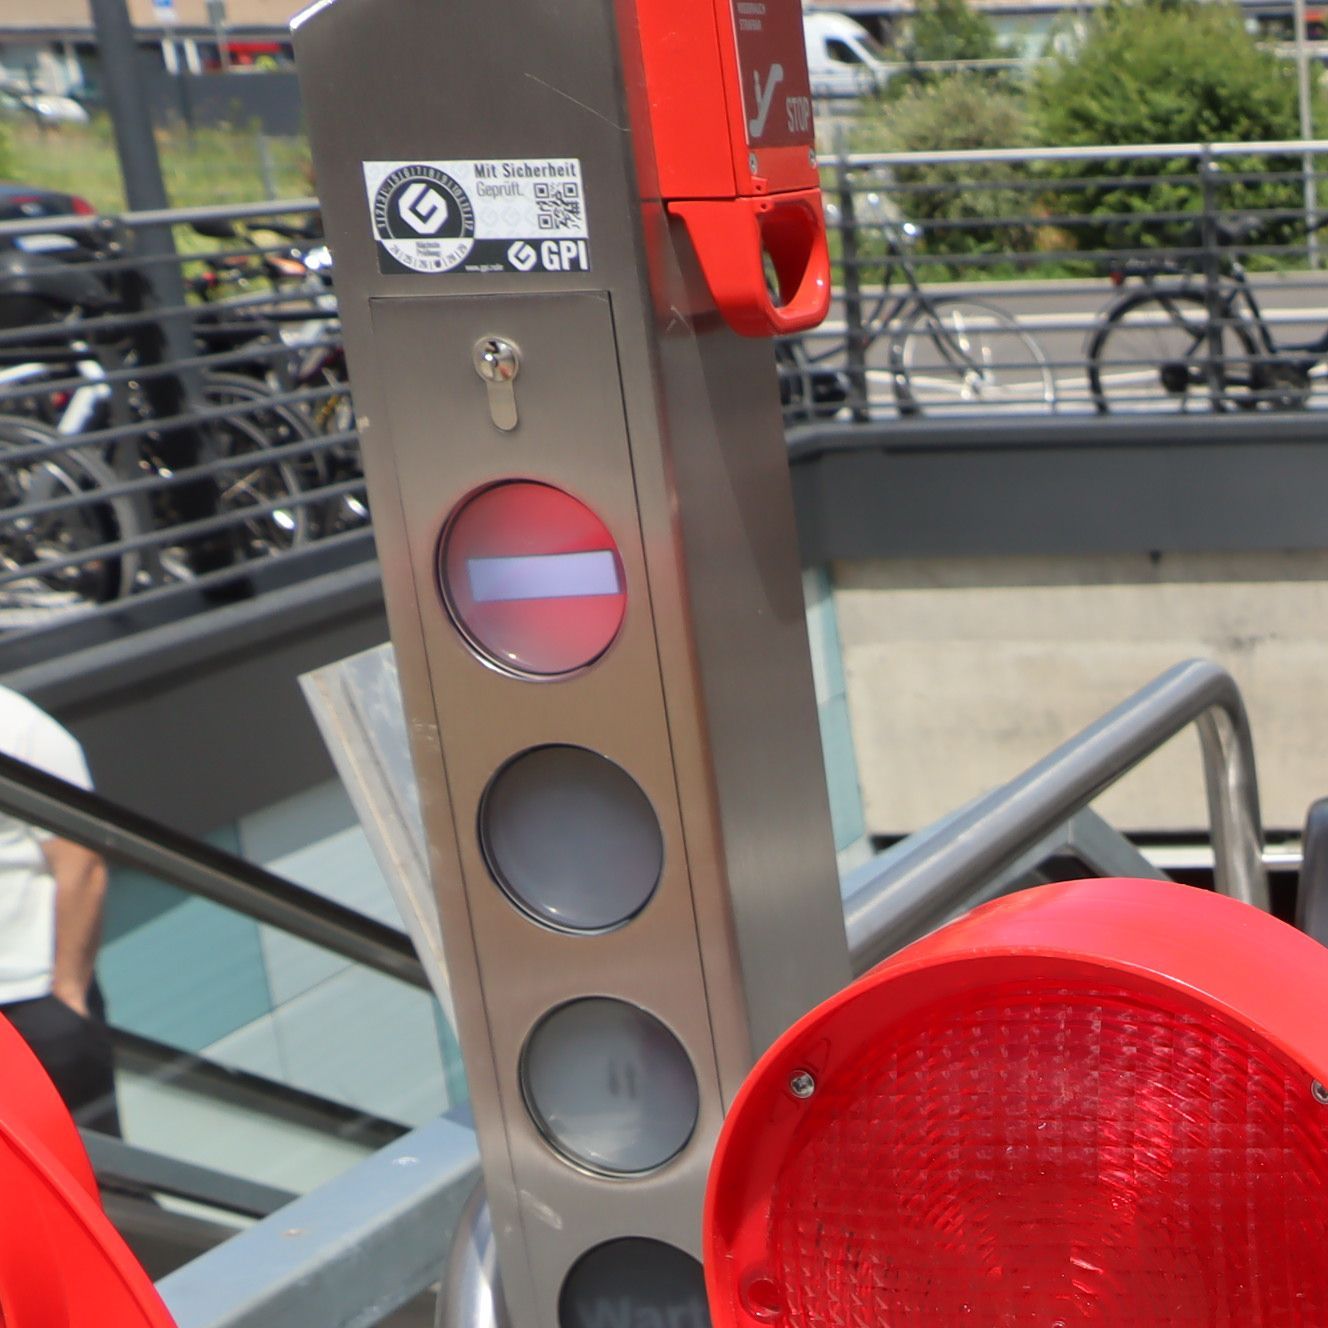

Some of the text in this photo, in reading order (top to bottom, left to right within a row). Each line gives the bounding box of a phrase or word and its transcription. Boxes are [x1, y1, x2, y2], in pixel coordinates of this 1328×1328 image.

[785, 96, 810, 133] STOP
[474, 162, 578, 178] Mit Sicherheit
[476, 180, 524, 200] Geprüft.
[541, 240, 589, 271] GPI
